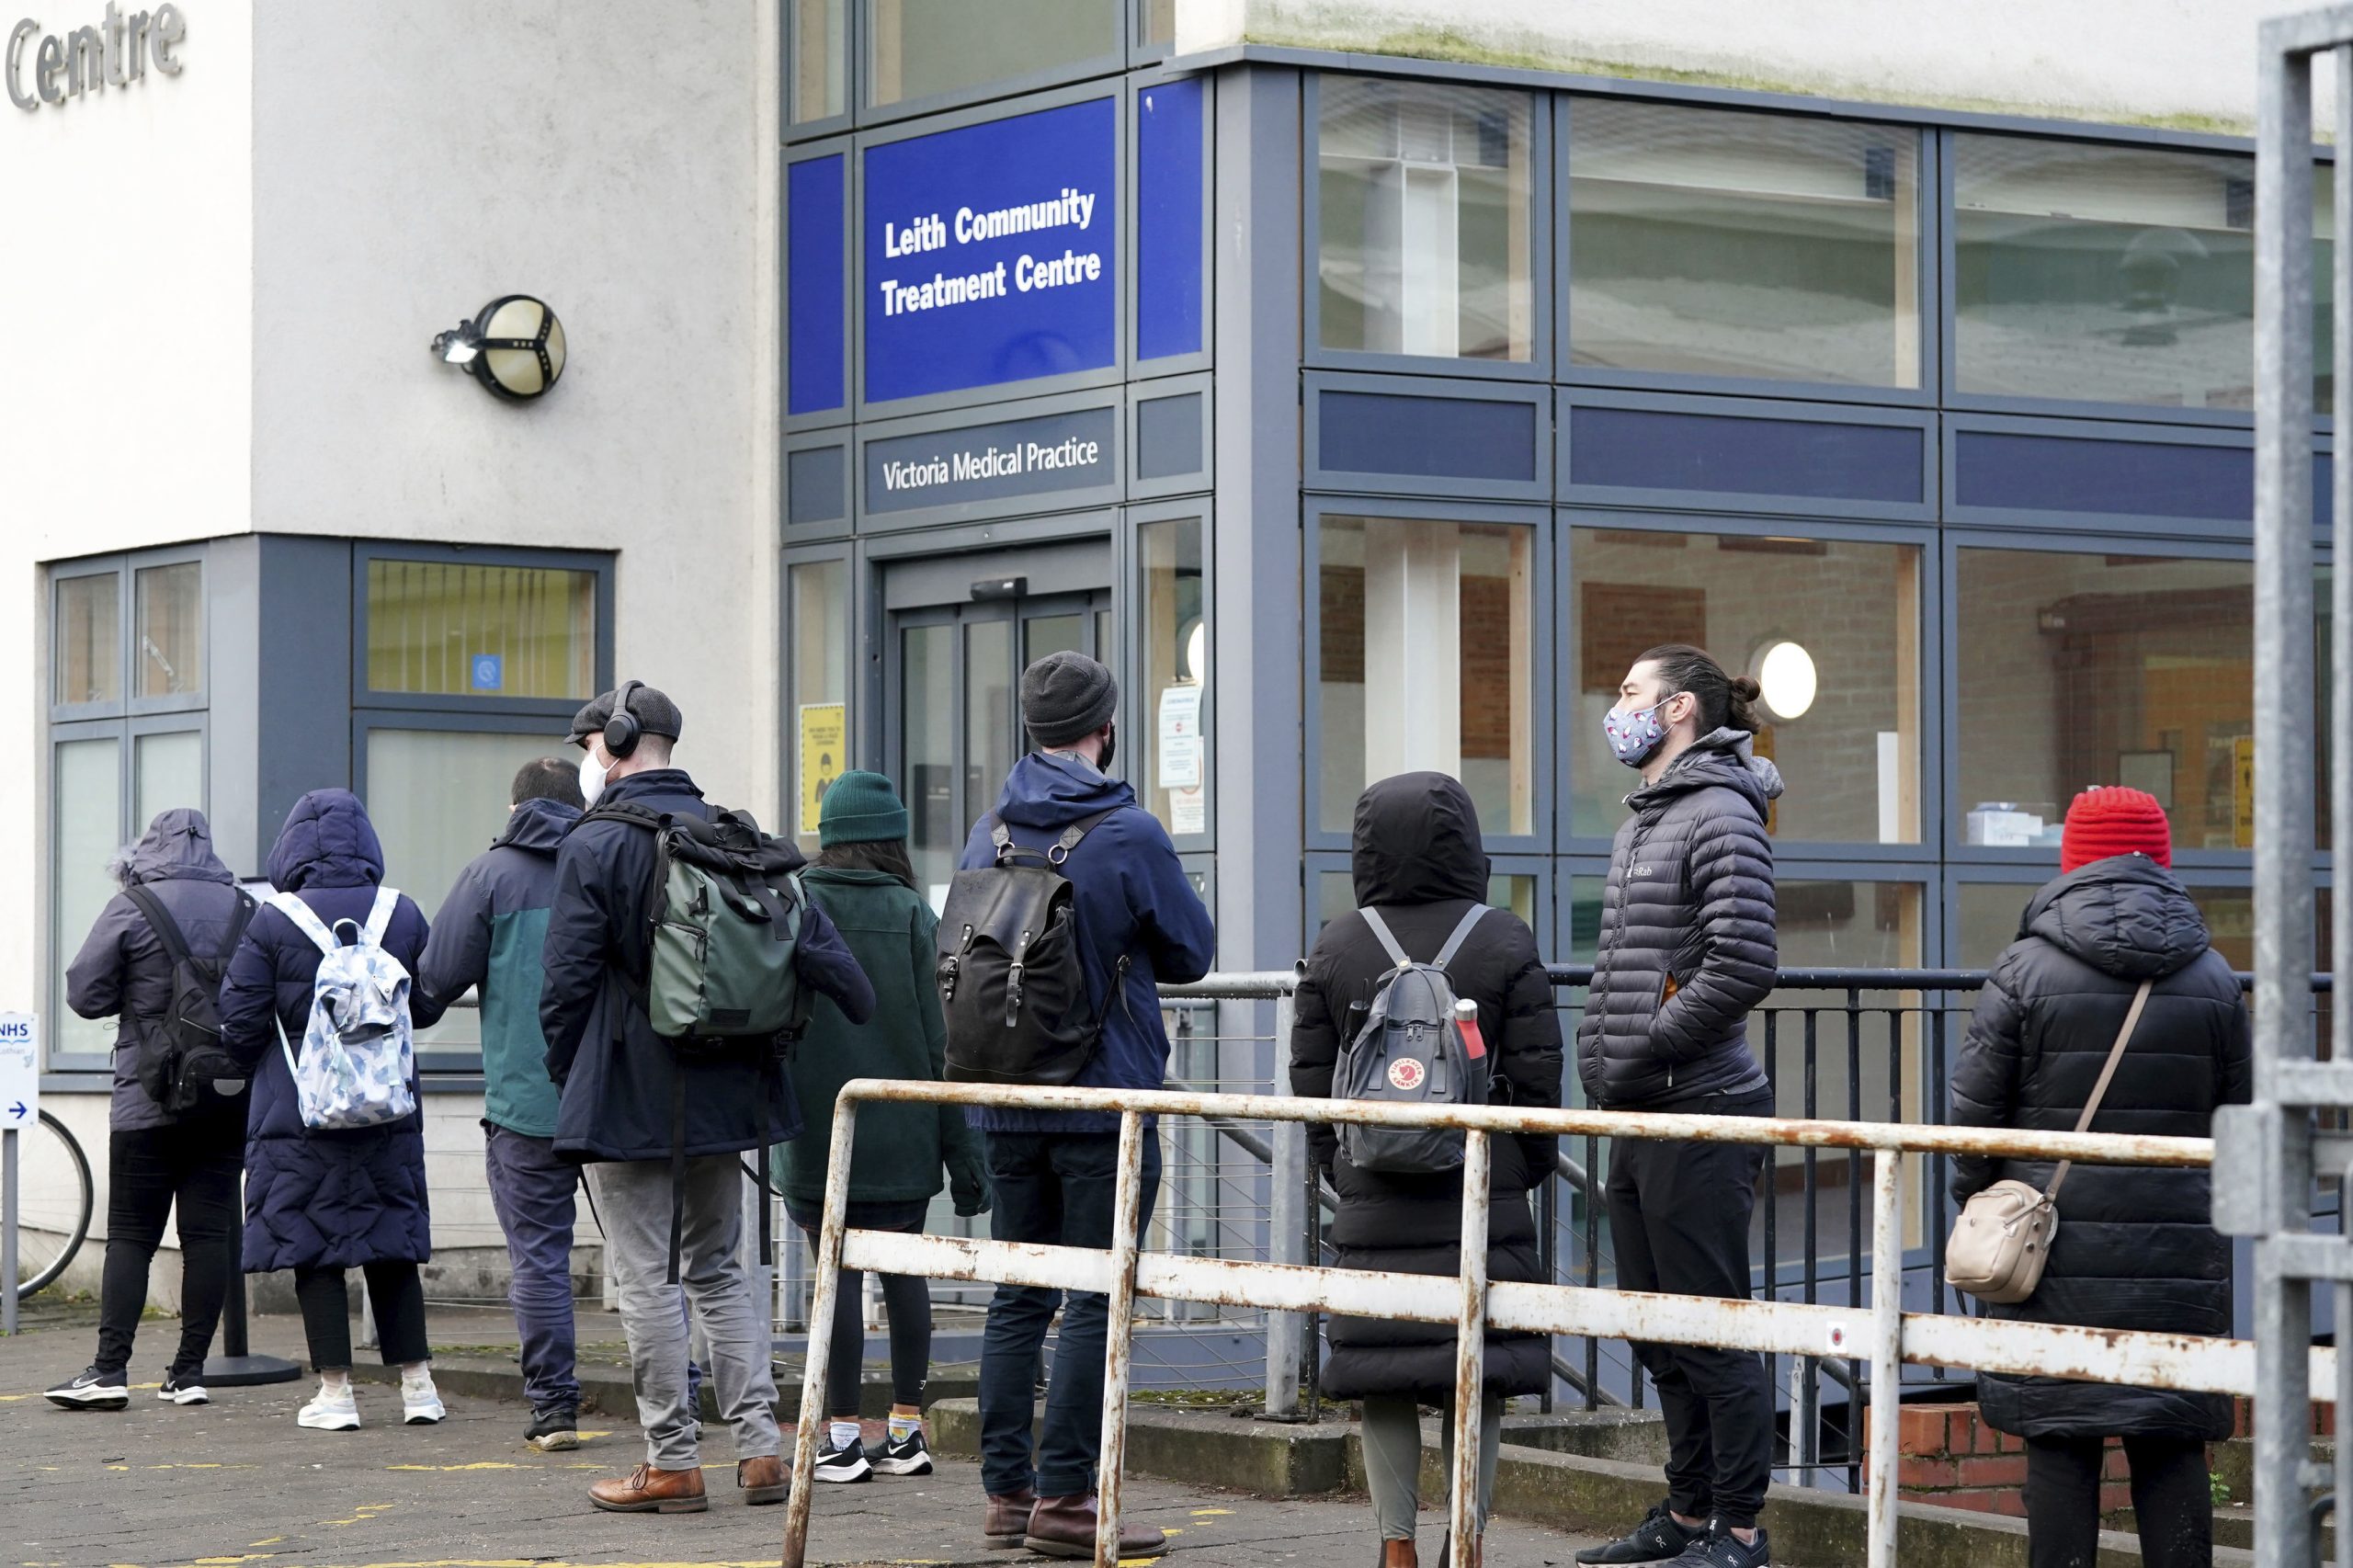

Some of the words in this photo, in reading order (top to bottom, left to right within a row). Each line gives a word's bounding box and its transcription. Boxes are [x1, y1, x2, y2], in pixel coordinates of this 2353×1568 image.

[6, 0, 186, 109] Centre
[885, 213, 947, 258] Leith
[954, 187, 1096, 244] Community
[881, 262, 1006, 316] Treatment
[1015, 250, 1101, 292] Centre
[883, 455, 949, 491] Victoria
[952, 443, 1022, 482] Medical
[1027, 437, 1098, 472] Practice
[1638, 867, 1653, 877] Rab
